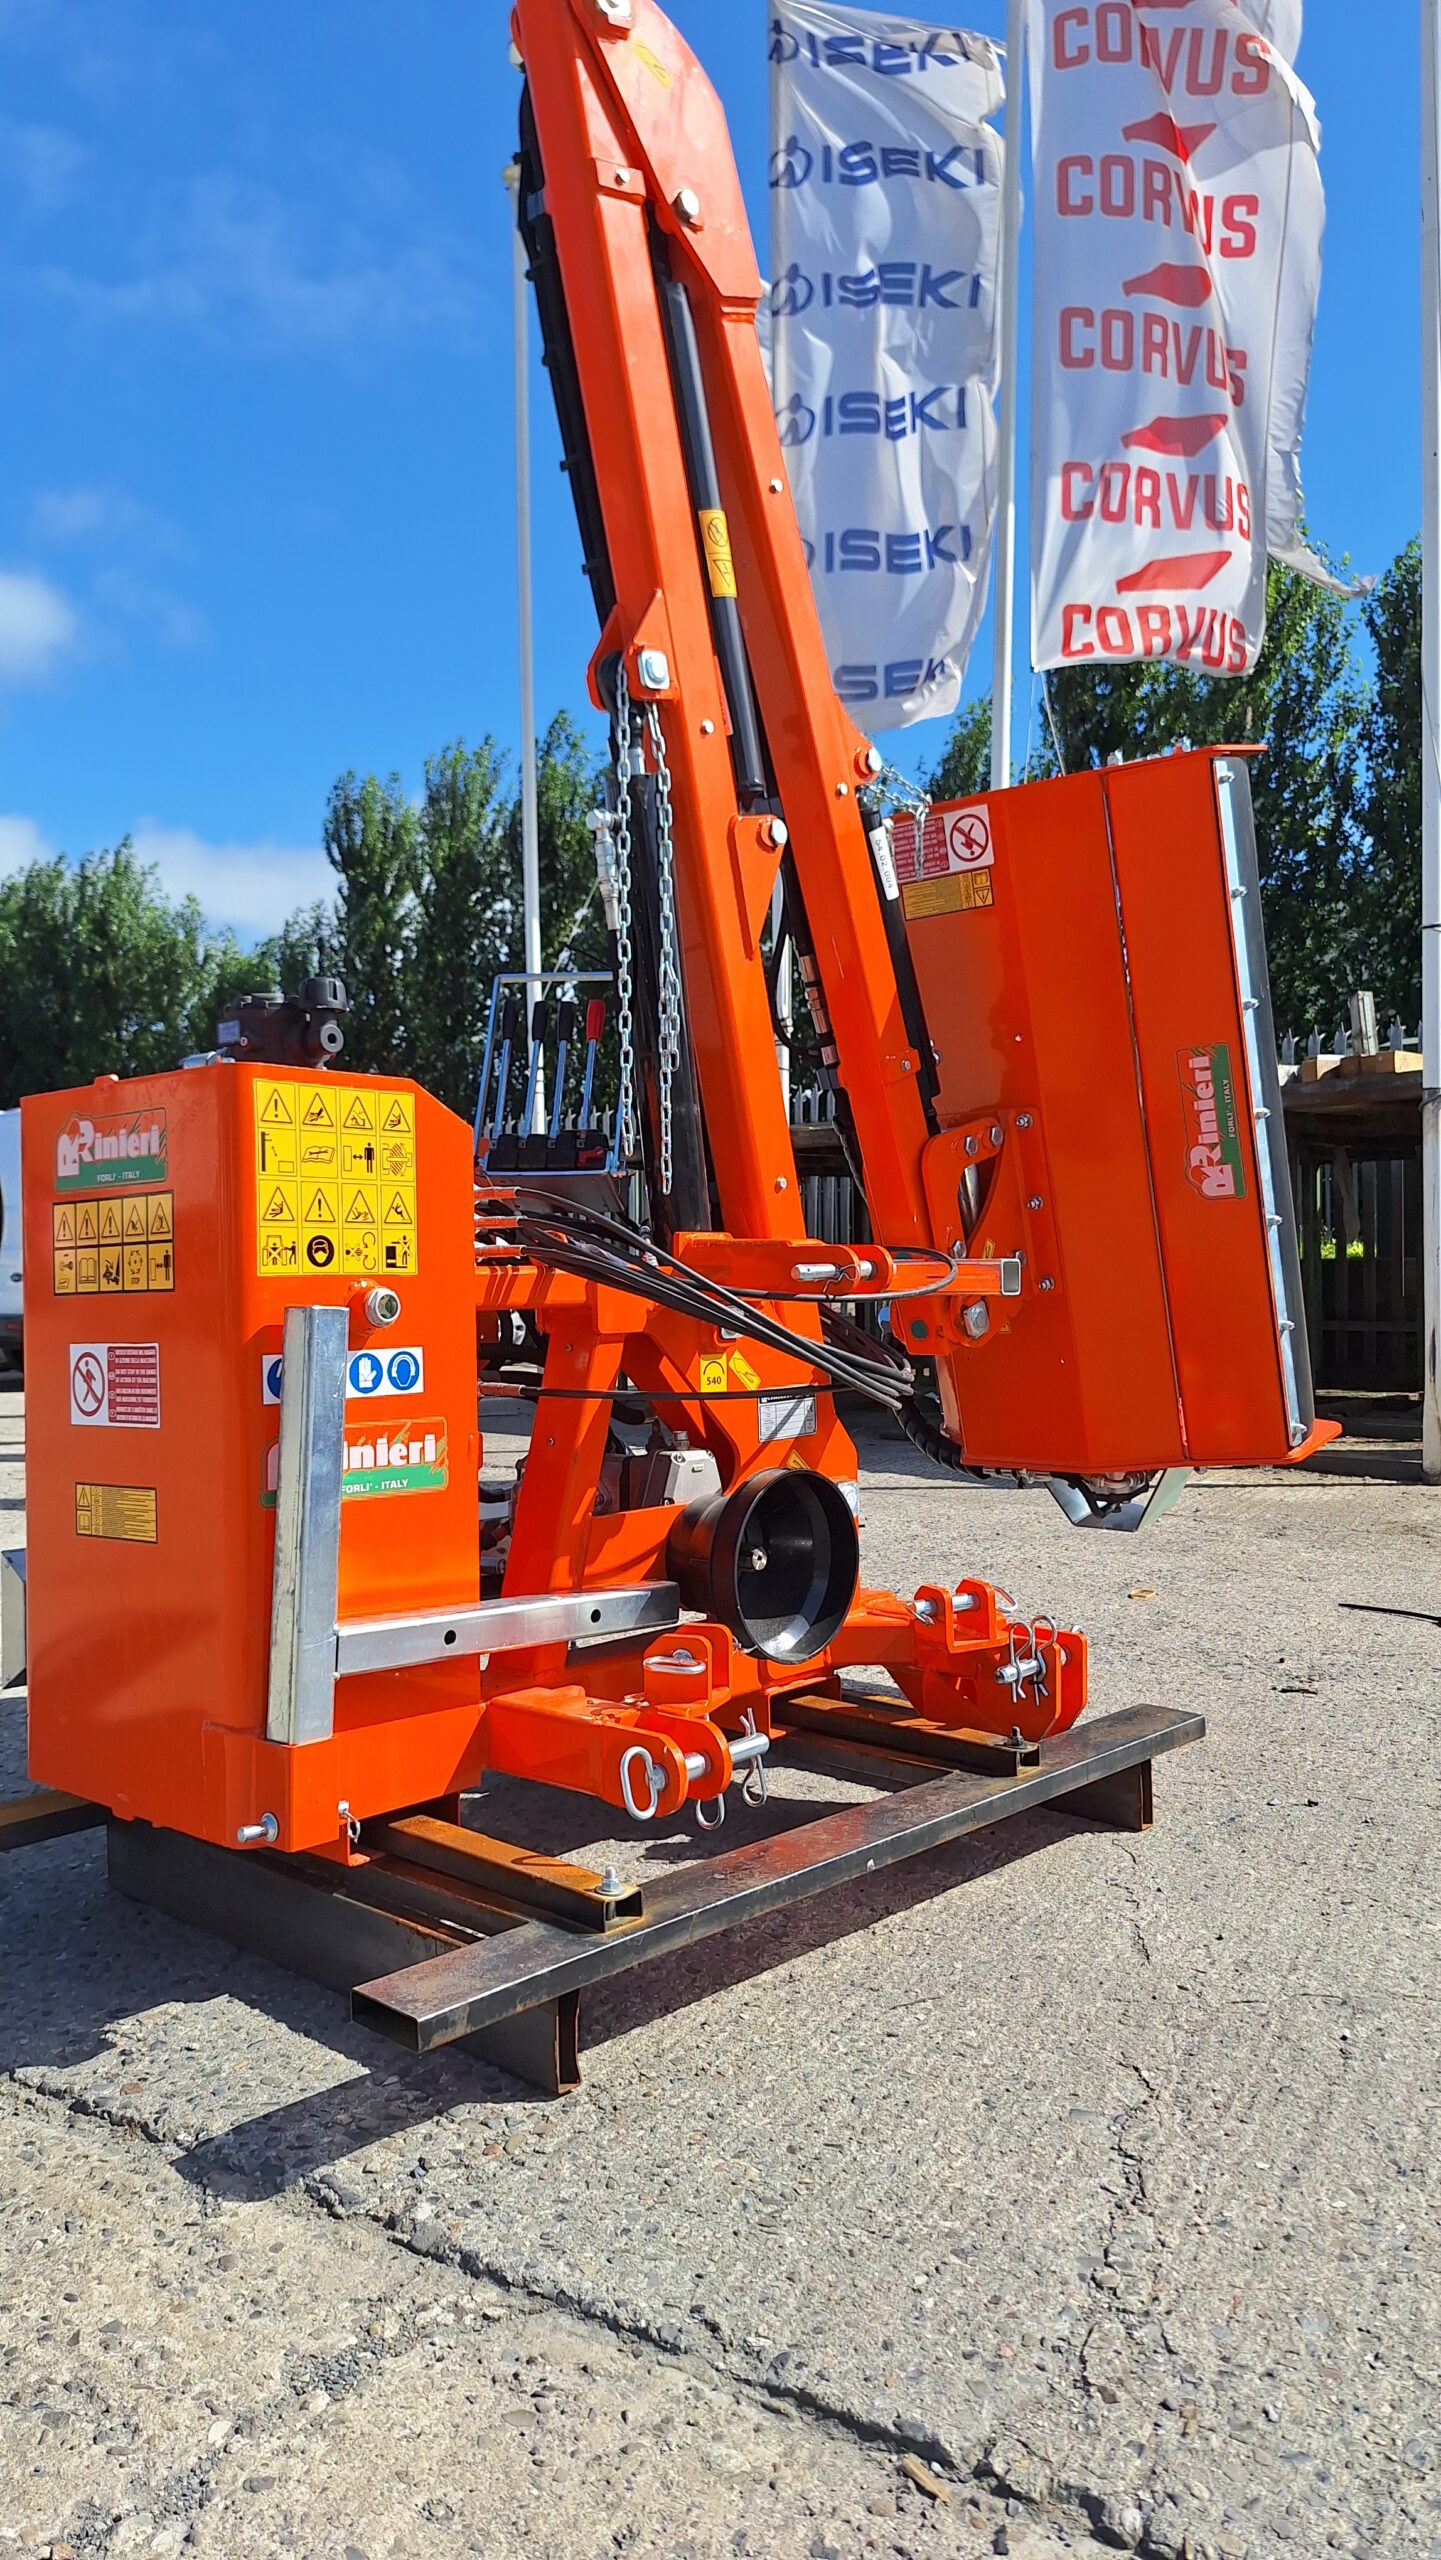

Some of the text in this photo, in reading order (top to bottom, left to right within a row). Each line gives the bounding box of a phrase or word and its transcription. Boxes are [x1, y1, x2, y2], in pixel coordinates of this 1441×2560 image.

[807, 32, 972, 75] ISEKI
[821, 140, 985, 190] ISEKI
[821, 261, 981, 309] ISEKI
[1059, 307, 1247, 407] CORVUS
[824, 386, 967, 442] ISEKI
[1061, 461, 1250, 541] CORVUS
[825, 525, 971, 575] ISEKI
[1061, 603, 1248, 673] CORVUS
[1222, 1079, 1232, 1103] ITALY
[123, 1170, 140, 1180] ITALY
[706, 1376, 722, 1386] 540
[381, 1479, 409, 1490] ITALY
